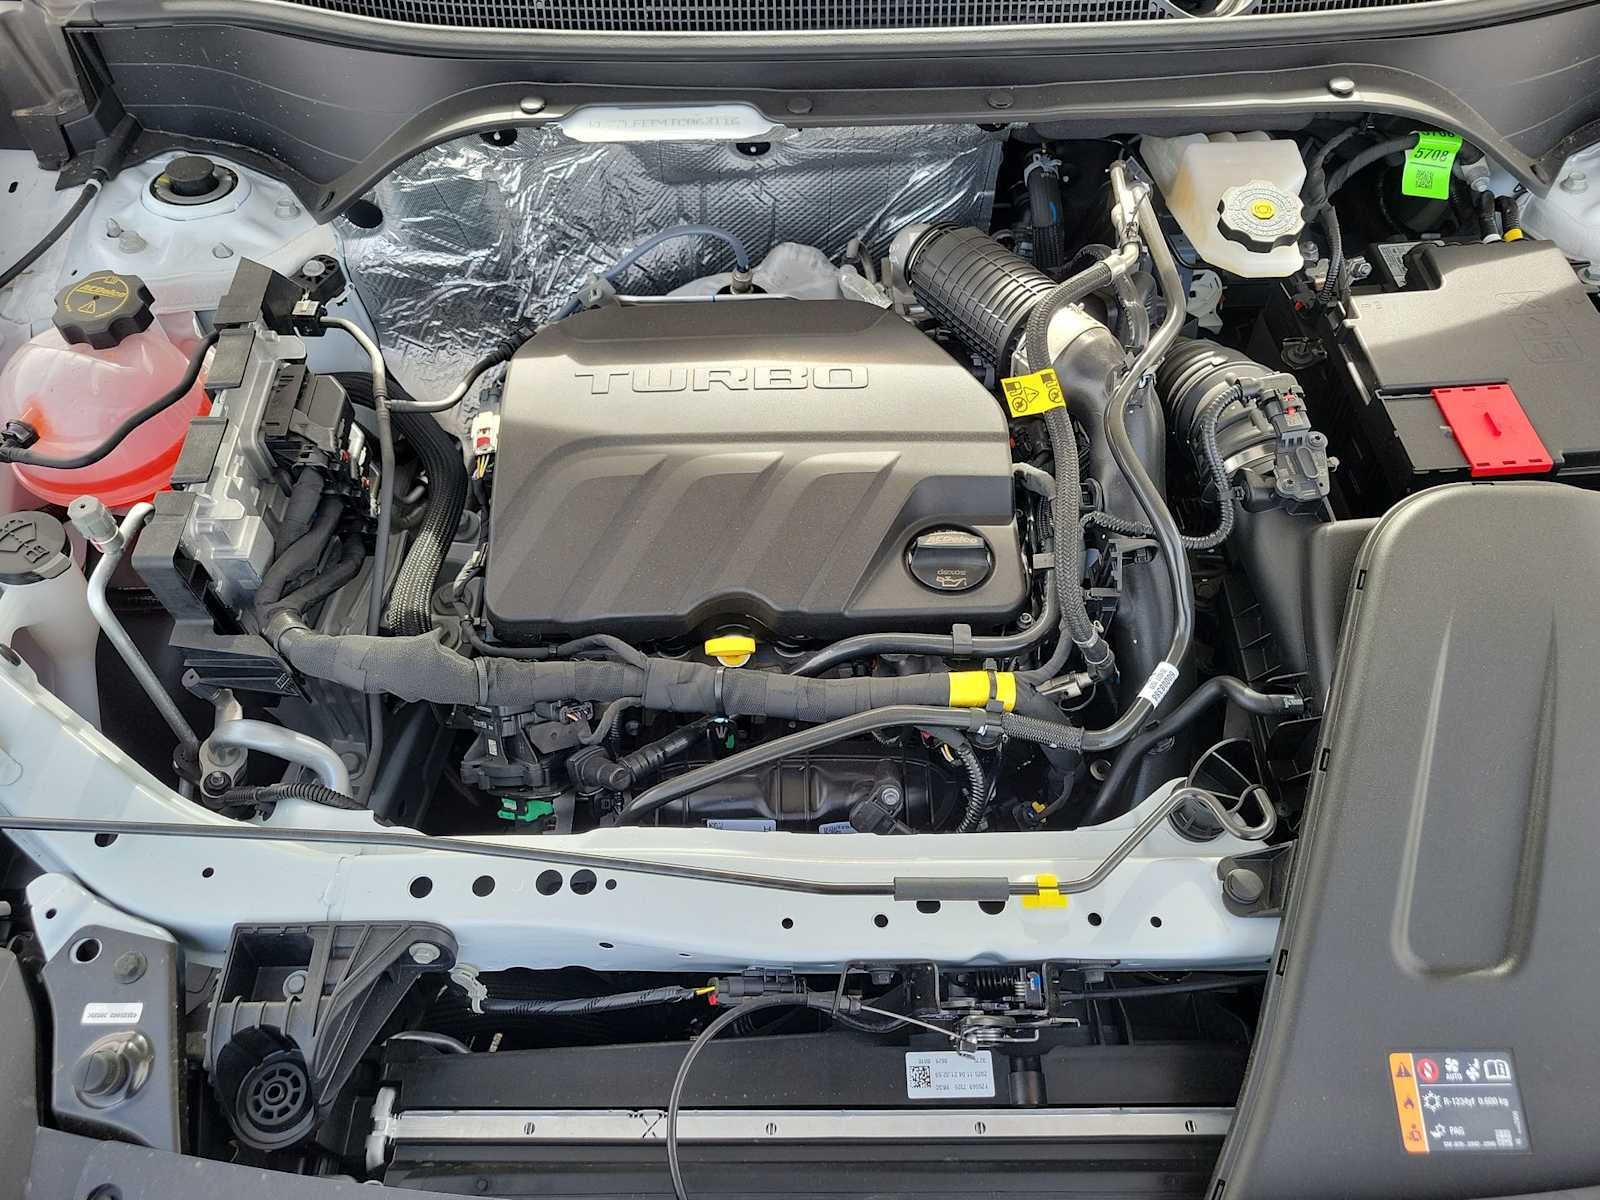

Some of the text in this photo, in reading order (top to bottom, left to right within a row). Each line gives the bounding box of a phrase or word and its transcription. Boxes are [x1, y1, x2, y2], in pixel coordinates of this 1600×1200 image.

[1414, 147, 1449, 161] 5708
[574, 367, 869, 395] TURBO
[1445, 1072, 1463, 1081] AUTO
